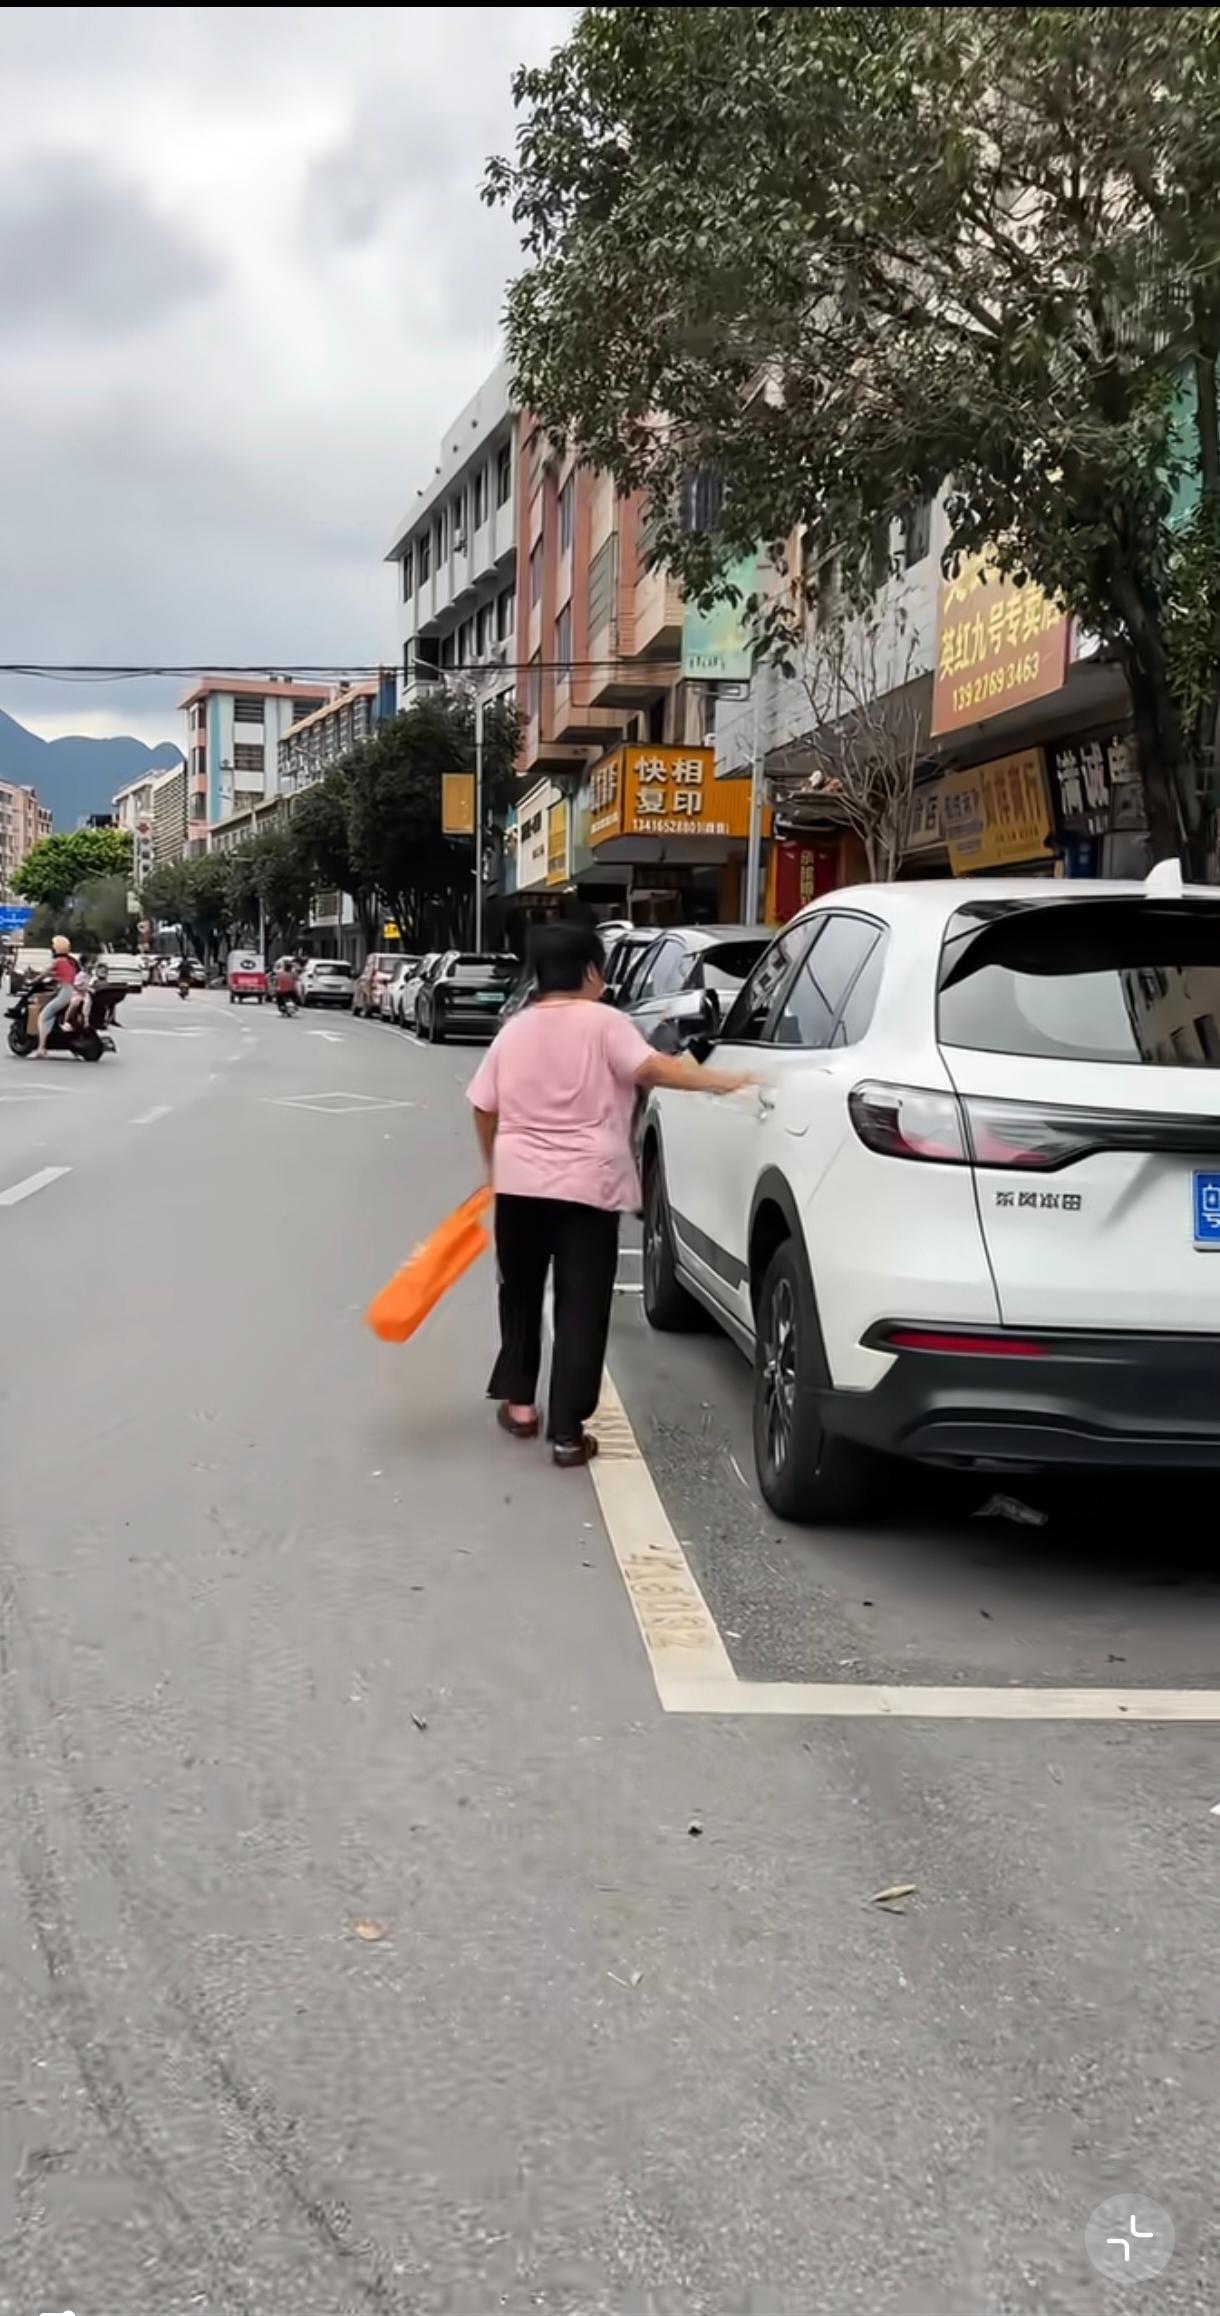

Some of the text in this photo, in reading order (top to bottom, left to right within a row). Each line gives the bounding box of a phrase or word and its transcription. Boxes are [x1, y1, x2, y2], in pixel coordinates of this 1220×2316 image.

[635, 756, 704, 785] 快相
[636, 787, 702, 815] 复印
[996, 1191, 1082, 1211] 东风本田
